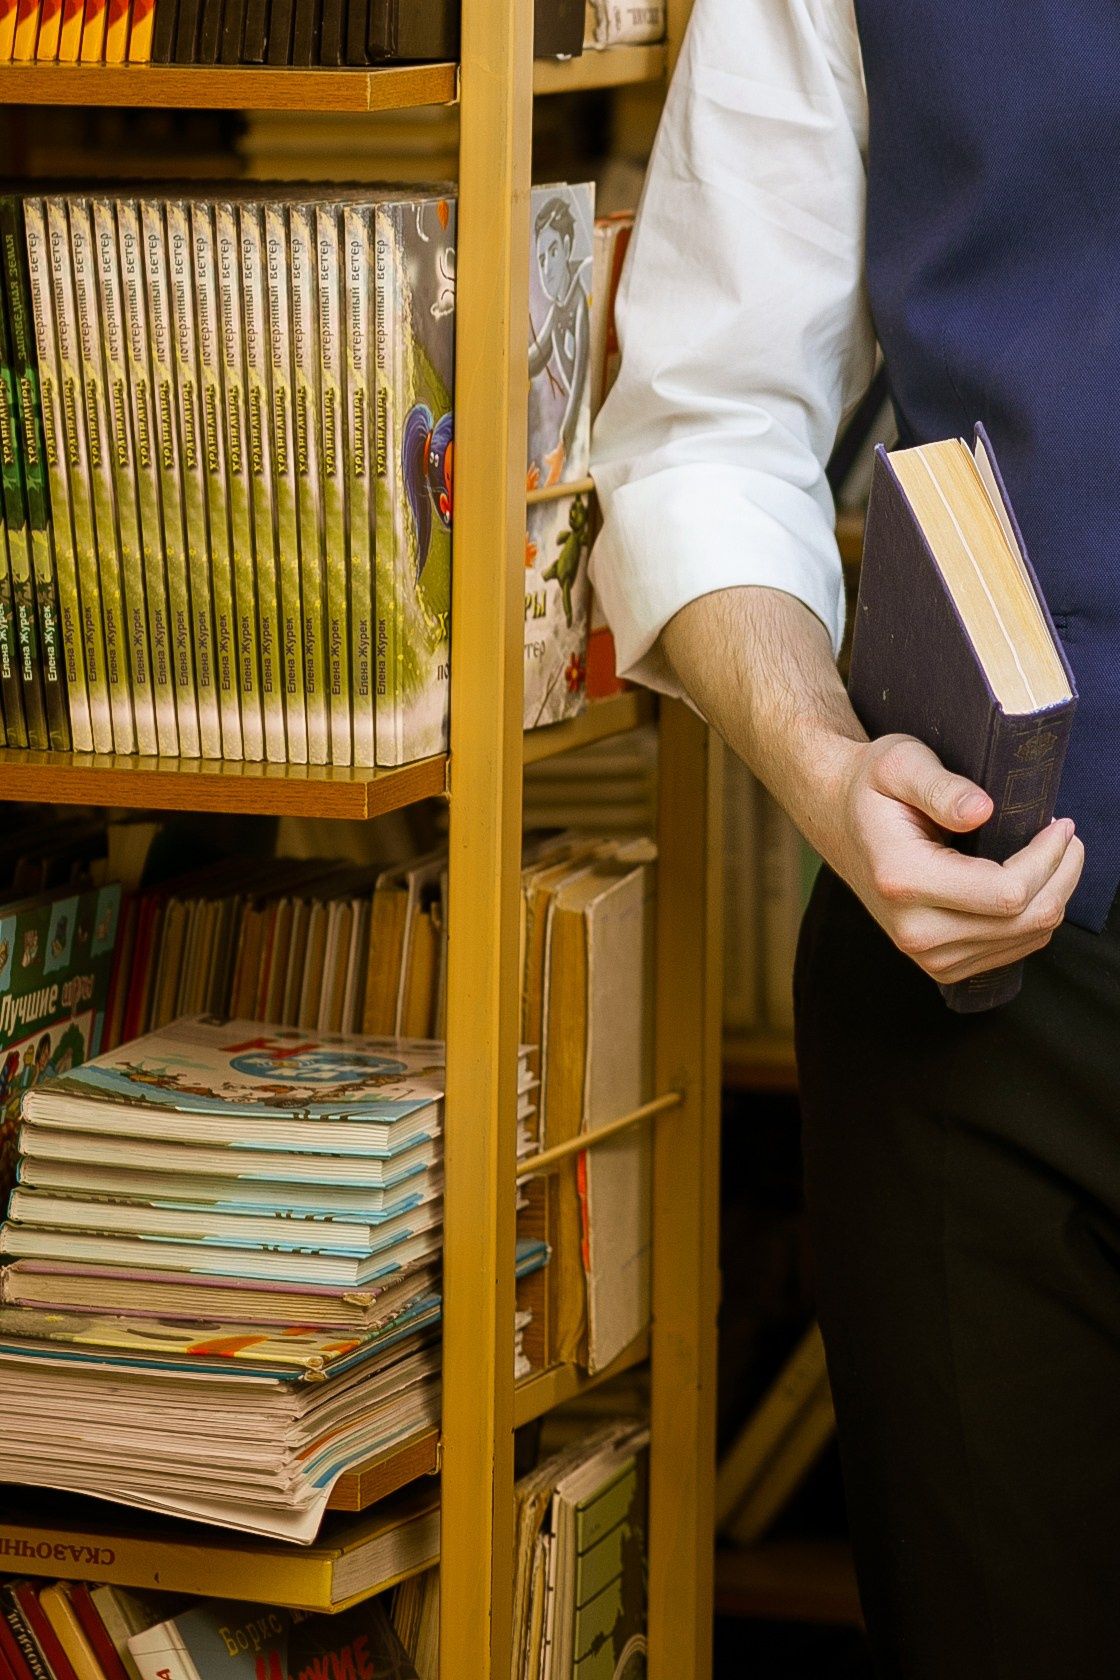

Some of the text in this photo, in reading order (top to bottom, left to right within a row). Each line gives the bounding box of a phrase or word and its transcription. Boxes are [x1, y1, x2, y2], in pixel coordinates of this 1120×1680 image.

[21, 378, 39, 464] ХРАНИМИРЫ
[1, 644, 11, 679] Елена
[19, 605, 33, 681] Елена Журек
[44, 605, 58, 681] Елена Журек
[64, 606, 77, 683] Елена Журек
[219, 614, 231, 691] Елена Журек
[241, 615, 253, 692] Елена Журек
[377, 619, 388, 695] Елена Журек
[0, 983, 58, 1037] Лучшие
[218, 1613, 282, 1657] Борис
